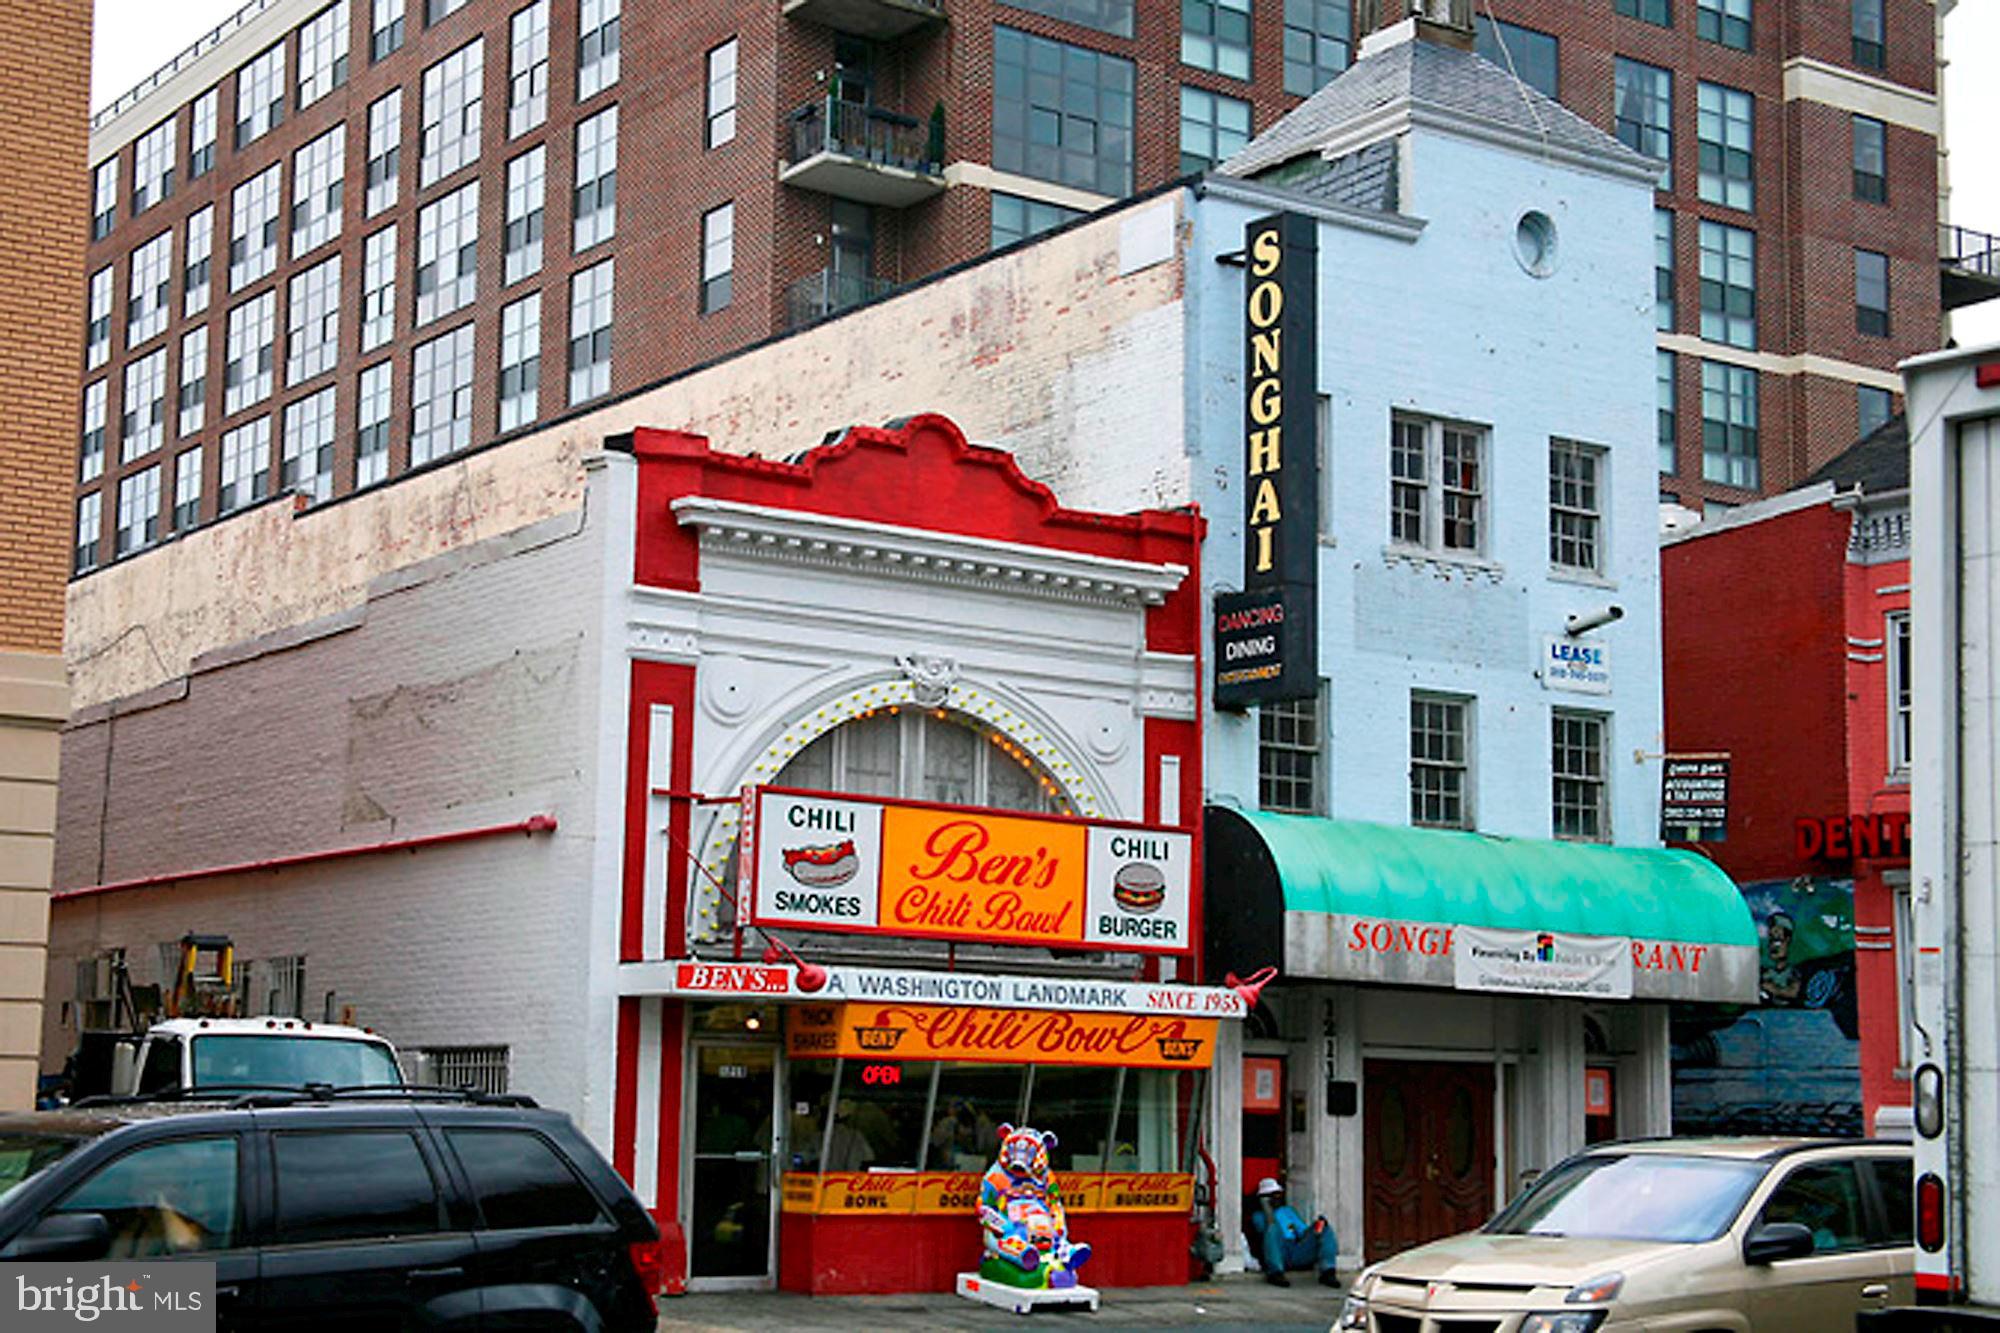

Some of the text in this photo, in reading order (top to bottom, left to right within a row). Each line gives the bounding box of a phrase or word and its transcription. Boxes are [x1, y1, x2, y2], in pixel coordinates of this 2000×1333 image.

[1249, 230, 1283, 573] SONGHAI
[1218, 603, 1283, 632] DANCING
[1226, 635, 1275, 661] DINING
[788, 805, 855, 833] CHILI
[909, 820, 1059, 889] Ben's
[1110, 836, 1169, 861] CHILI
[775, 891, 861, 917] SMOKES
[895, 885, 1073, 934] Chili Bowl
[1099, 915, 1178, 940] BURGER
[1472, 946, 1520, 963] Financing
[828, 974, 1127, 1008] A WASHINGTON LANDMARK
[1147, 990, 1240, 1014] SINCE 1958
[926, 1005, 1152, 1055] Chili Bowl
[862, 1065, 900, 1085] OPEN
[844, 1194, 888, 1208] BOWL
[1116, 1193, 1179, 1207] BURGERS
